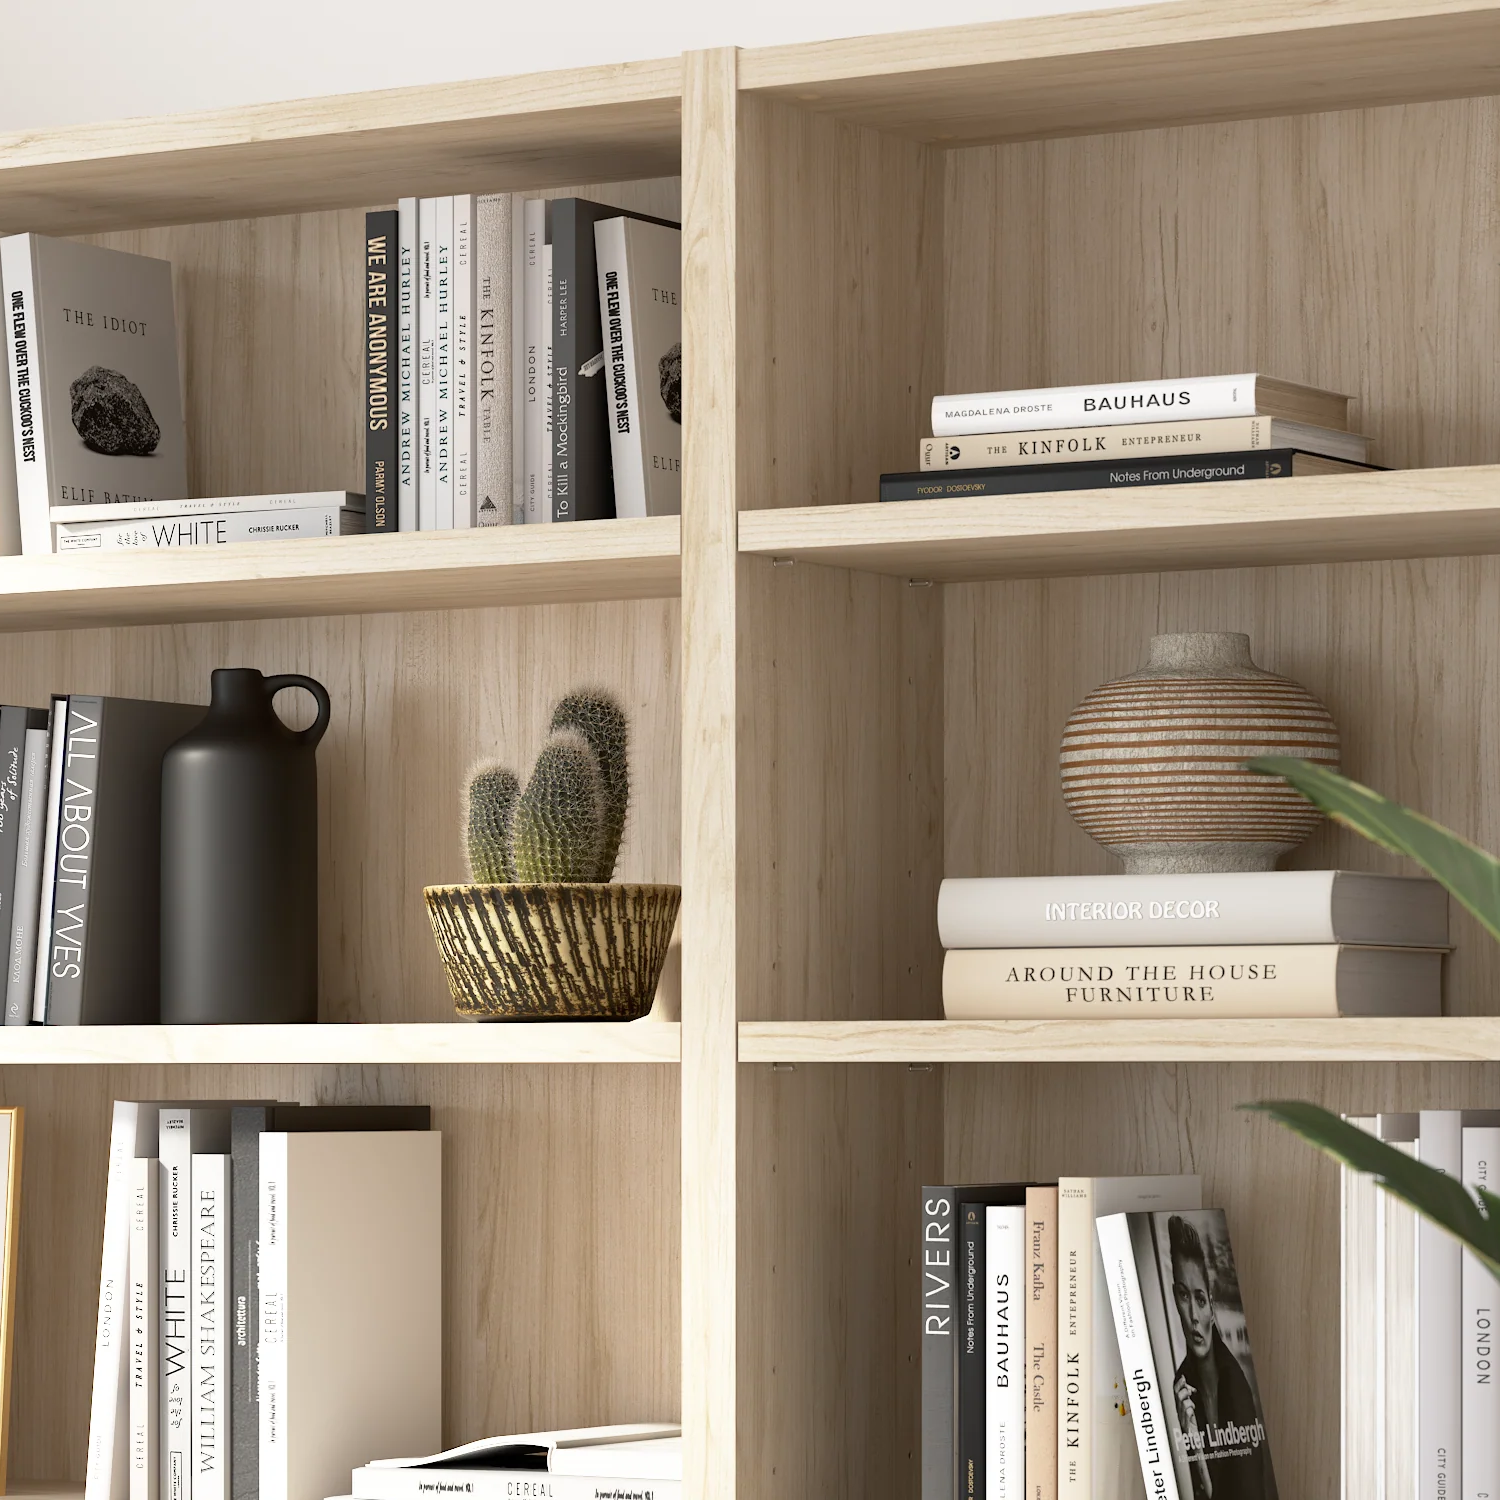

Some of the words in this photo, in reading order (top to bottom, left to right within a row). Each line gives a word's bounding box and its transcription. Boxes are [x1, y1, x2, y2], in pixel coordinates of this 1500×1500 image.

[368, 236, 386, 266] WE
[369, 269, 386, 309] ARE
[401, 245, 411, 314] HURLEY
[482, 277, 491, 300] THE
[11, 291, 23, 311] ONE
[13, 312, 27, 339] FLEW
[63, 308, 94, 327] THE
[103, 316, 148, 336] IDIOT
[16, 341, 28, 367] OVER
[401, 323, 411, 402] MICHAEL
[480, 308, 494, 401] KINFOLK
[18, 367, 30, 387] THE
[369, 313, 388, 431] ANONYMOUS
[19, 388, 33, 437] CUCKOO'S
[557, 366, 571, 442] Mockingbird
[944, 408, 1011, 418] MAGDALENA
[1013, 404, 1053, 413] DROSTE
[1084, 391, 1191, 412] BAUHAUS
[482, 406, 491, 443] TABLE
[23, 437, 35, 462] NEST
[401, 411, 411, 487] ANDREW
[987, 445, 1007, 455] THE
[1019, 437, 1106, 455] KINFOLK
[1122, 433, 1202, 446] ENTEPRENEUR
[375, 460, 385, 496] PARMY
[560, 453, 568, 470] a
[1110, 471, 1140, 483] Notes
[1144, 470, 1170, 481] From
[1172, 465, 1245, 481] Underground
[61, 486, 95, 502] ELIF
[557, 474, 568, 498] Kill
[917, 486, 943, 495] FYODOR
[946, 483, 986, 492] DOSTOEVSKY
[375, 498, 385, 527] OLSON
[557, 501, 568, 518] To
[152, 520, 226, 547] WHITE
[68, 708, 98, 768] ALL
[59, 778, 93, 889] ABOUT
[1045, 903, 1143, 921] INTERIOR
[1150, 900, 1220, 919] DECOR
[52, 904, 85, 979] YVES
[1006, 966, 1113, 982] AROUND
[1126, 965, 1177, 981] THE
[1190, 964, 1278, 980] HOUSE
[1066, 986, 1215, 1003] FURNITURE
[1033, 1220, 1044, 1258] Franz
[200, 1190, 215, 1356] SHAKESPEARE
[926, 1196, 950, 1336] RIVERS
[1033, 1262, 1044, 1301] Kafka
[165, 1270, 186, 1376] WHITE
[237, 1296, 246, 1346] architettura
[997, 1273, 1008, 1388] BAUHAUS
[1034, 1343, 1044, 1372] The
[1477, 1308, 1490, 1385] LONDON
[1033, 1375, 1044, 1413] Castle
[200, 1360, 215, 1473] WILLIAM
[1133, 1368, 1159, 1465] Lindbergh
[1173, 1424, 1205, 1451] Peter
[1207, 1418, 1265, 1447] Lindbergh
